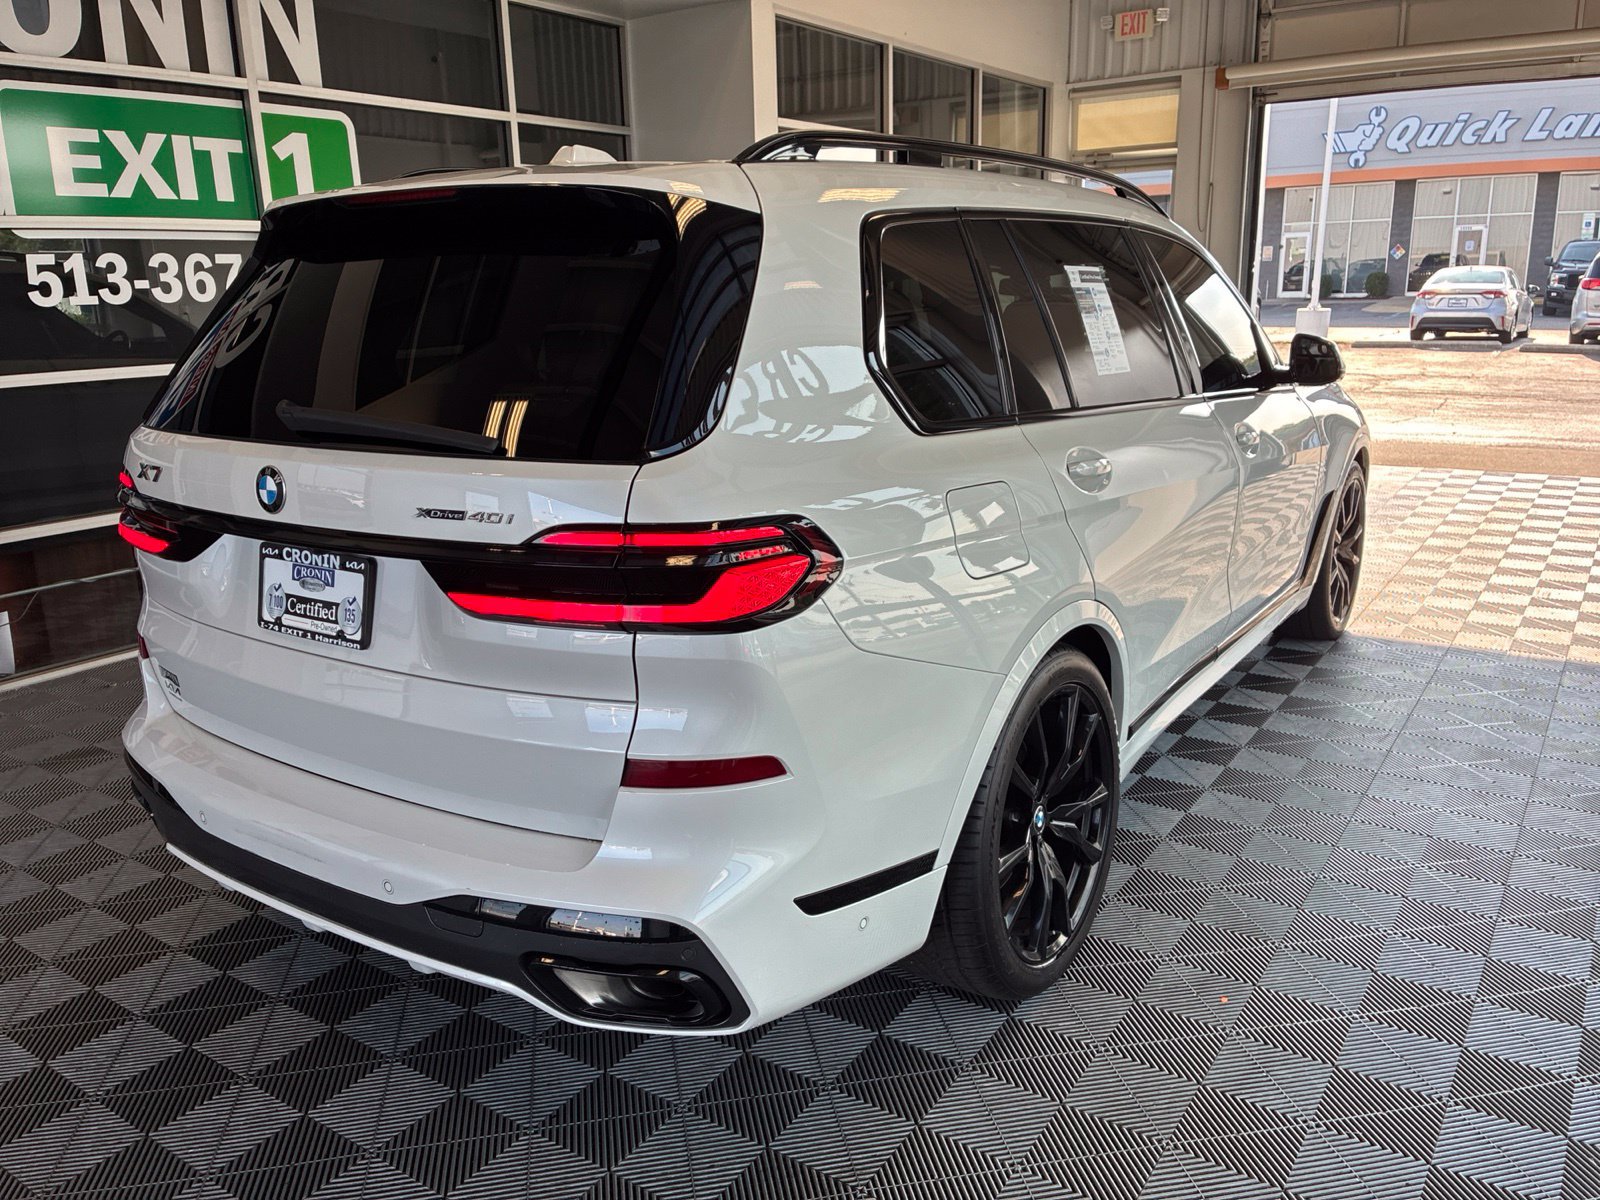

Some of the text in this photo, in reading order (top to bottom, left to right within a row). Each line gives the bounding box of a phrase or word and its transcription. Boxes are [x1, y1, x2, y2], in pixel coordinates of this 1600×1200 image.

[1120, 12, 1148, 36] EXIT
[1386, 110, 1521, 153] Quick
[46, 126, 314, 202] EXIT 1
[25, 252, 243, 307] 513-367
[137, 462, 163, 482] X7
[282, 547, 341, 570] CRONIN
[293, 565, 334, 585] CRONIN
[287, 597, 336, 621] Certified
[344, 608, 356, 624] 135
[260, 621, 279, 632] I-74
[281, 626, 304, 637] EXIT
[315, 633, 361, 650] Harrison
[310, 620, 338, 633] Pre-Owned
